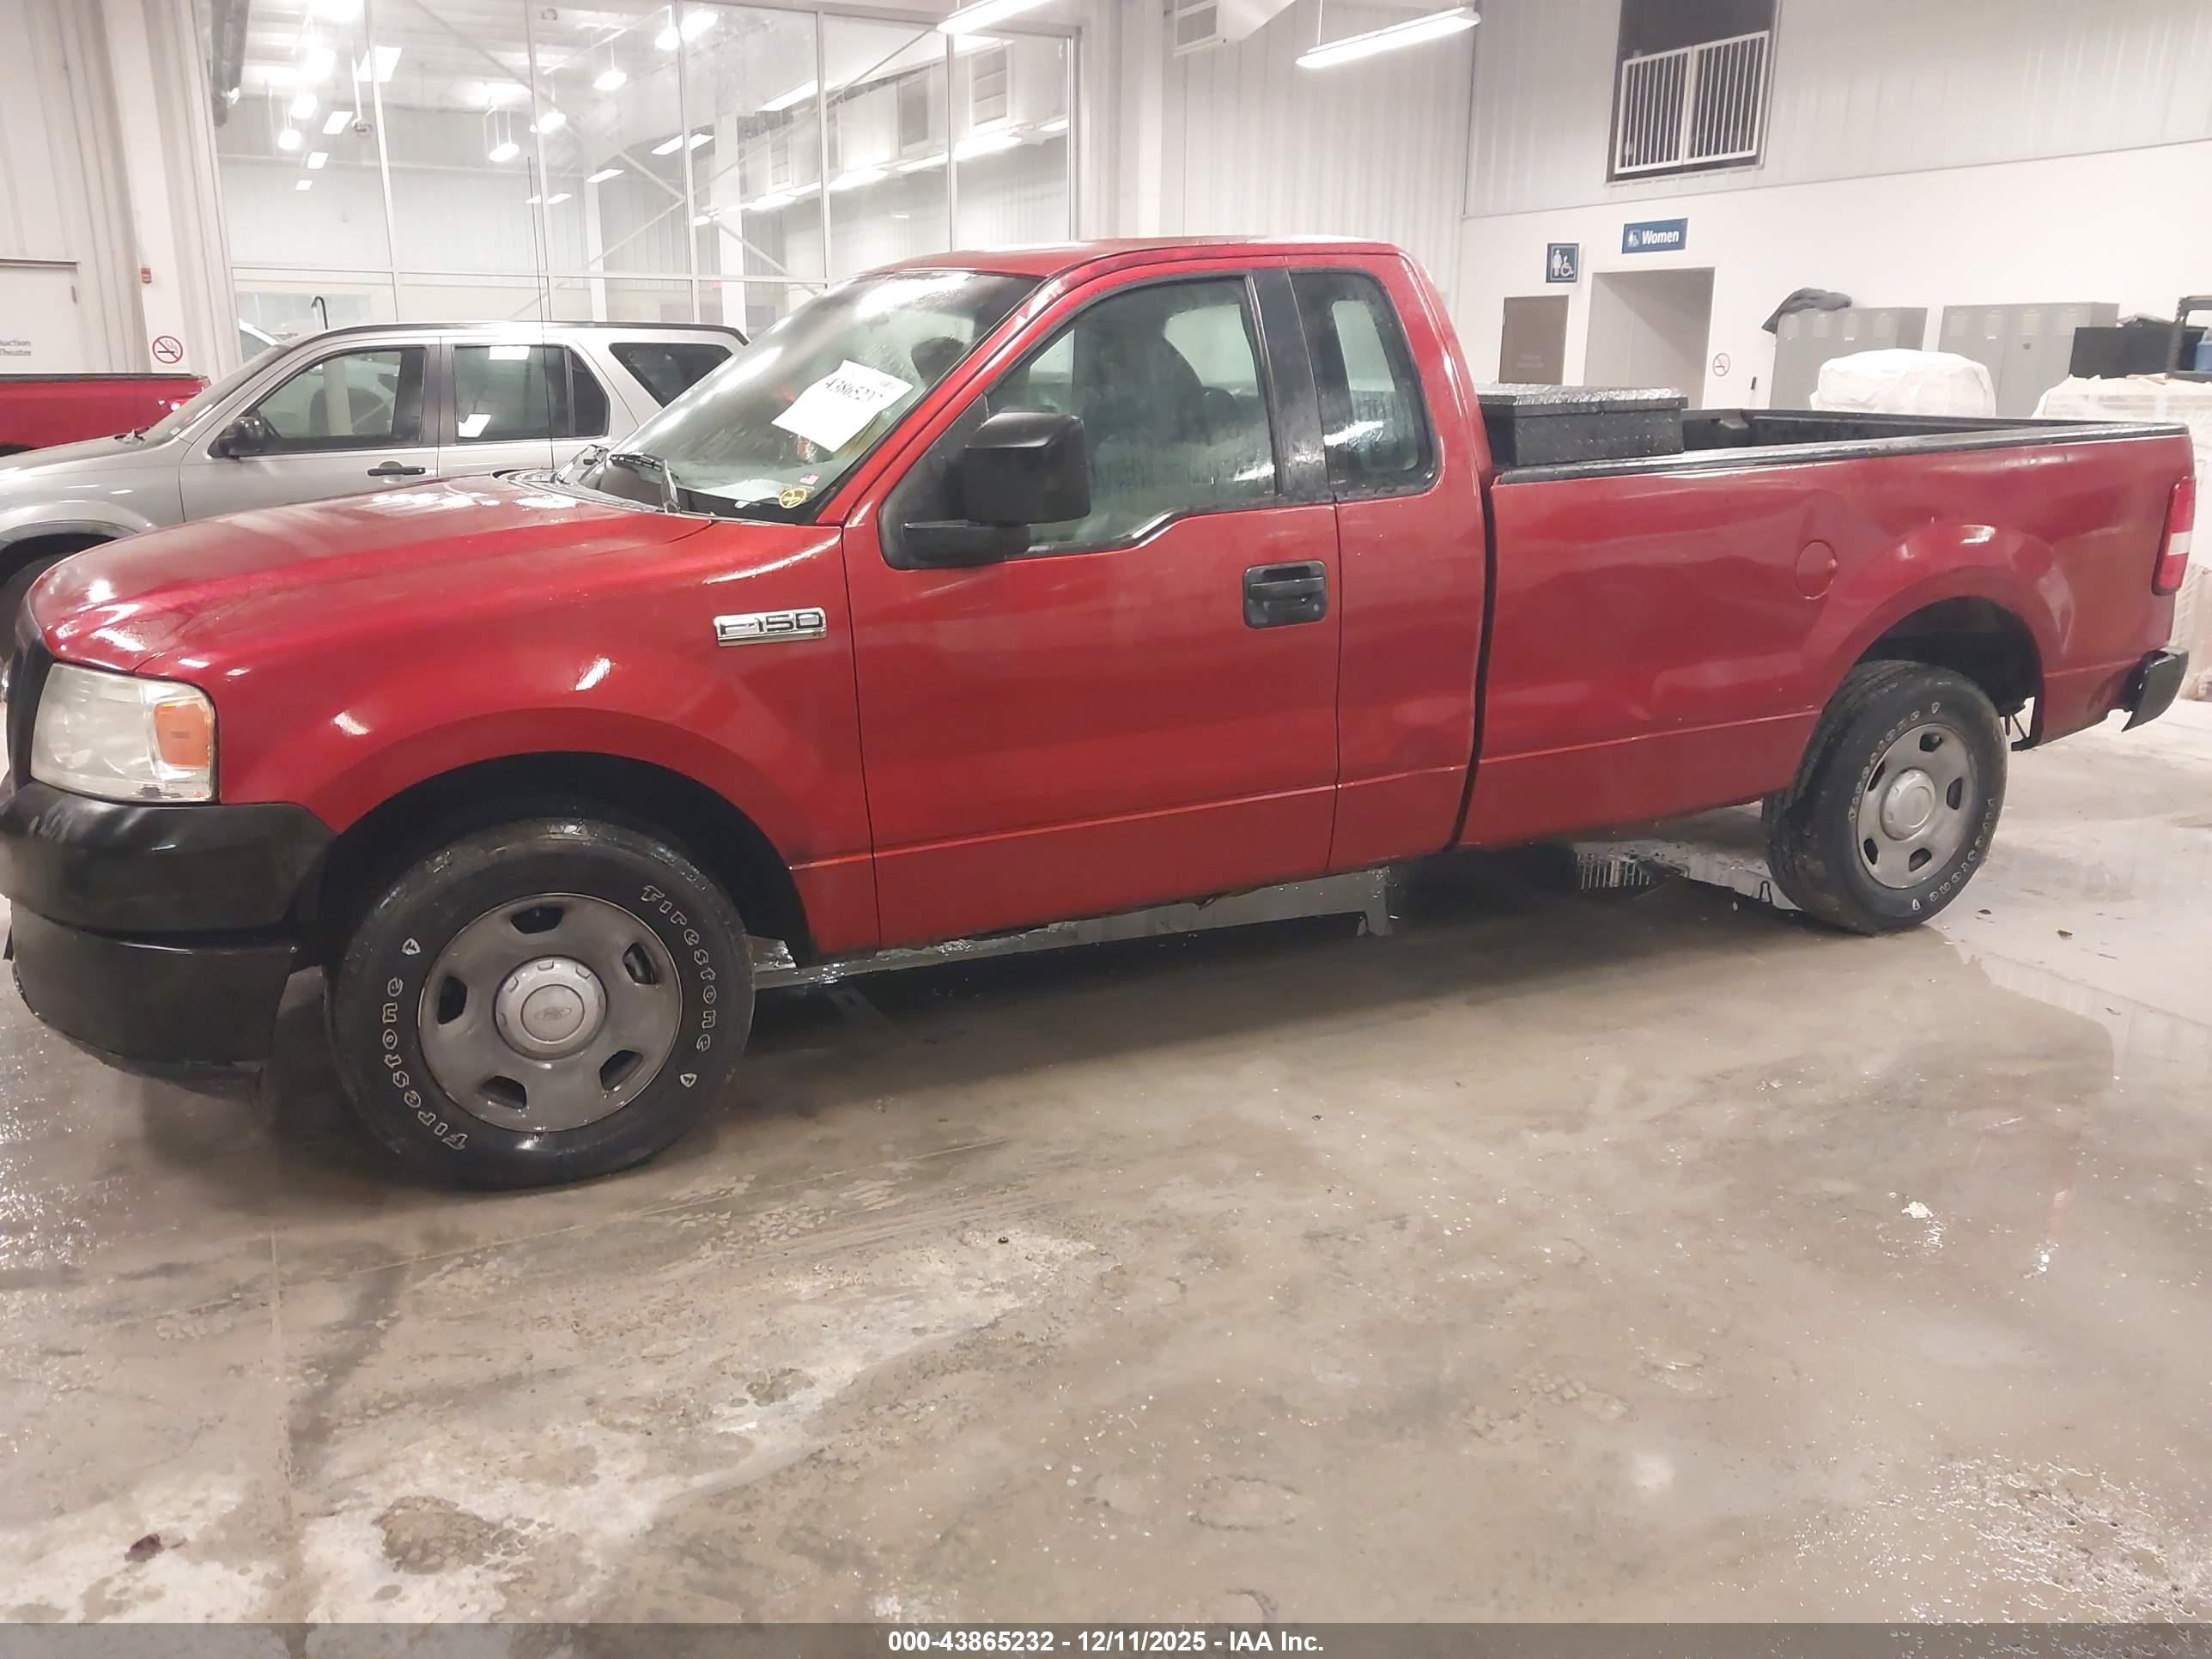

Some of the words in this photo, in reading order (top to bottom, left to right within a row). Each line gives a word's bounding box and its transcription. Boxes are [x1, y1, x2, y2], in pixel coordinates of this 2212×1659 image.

[1642, 229, 1680, 245] Women
[641, 884, 716, 1052] Firestone
[381, 977, 468, 1151] Firestone
